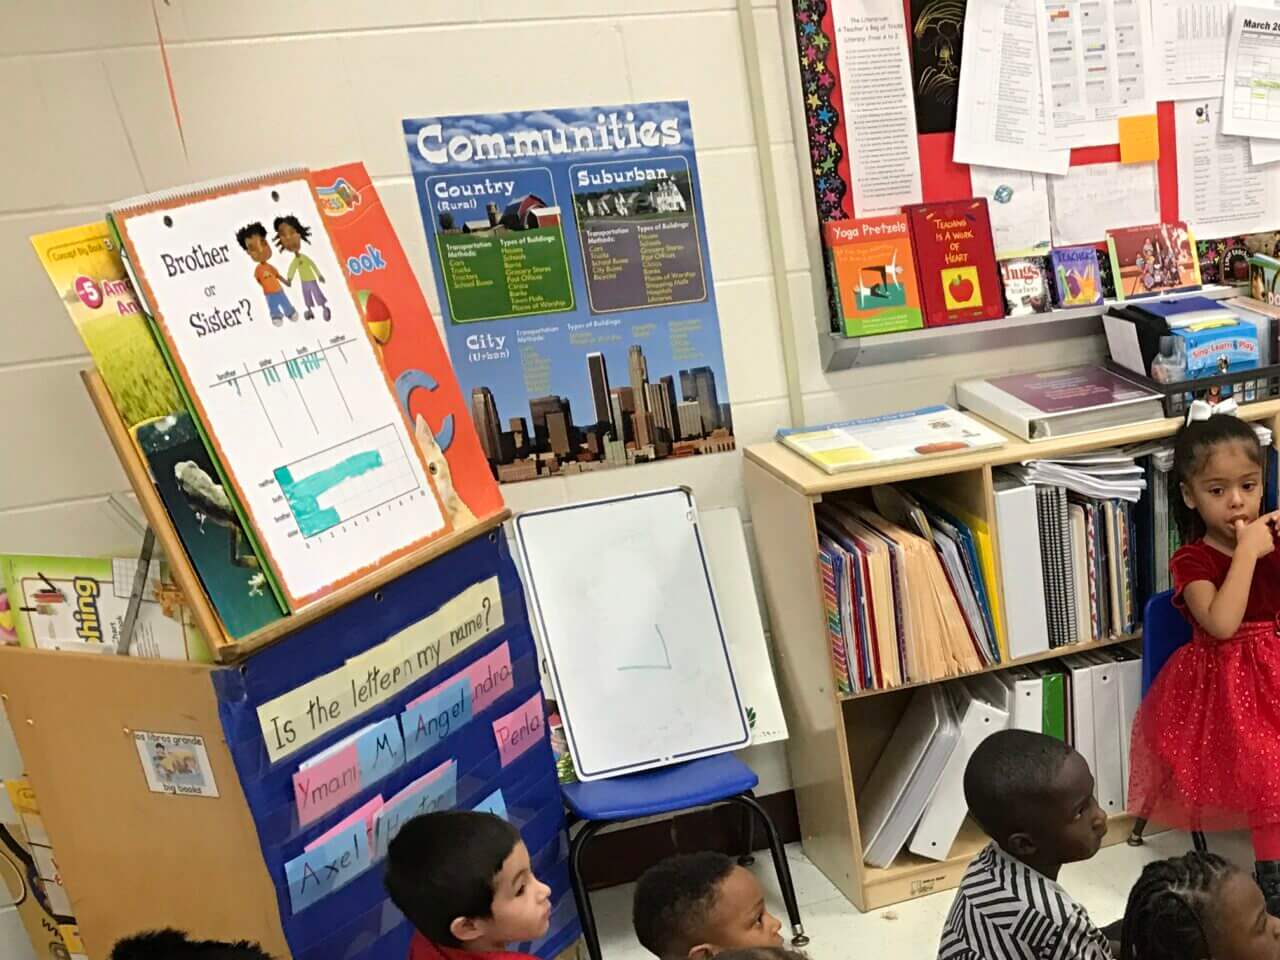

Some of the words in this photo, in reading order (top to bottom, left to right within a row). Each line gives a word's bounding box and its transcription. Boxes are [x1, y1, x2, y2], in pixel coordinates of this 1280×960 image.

[1243, 19, 1270, 31] March
[417, 111, 681, 165] Communities
[434, 178, 515, 198] Country
[577, 166, 668, 187] Suburban
[437, 199, 477, 211] (Rural)
[833, 227, 859, 240] Yoga
[862, 222, 906, 236] Pretzels
[51, 247, 76, 261] Concept
[160, 244, 230, 277] Brother
[347, 244, 387, 275] ook
[204, 285, 216, 298] or
[189, 298, 253, 338] Sister?
[466, 333, 506, 350] City
[468, 349, 510, 362] (Urban)
[1211, 341, 1232, 353] Learn
[1238, 340, 1255, 352] Play
[73, 576, 104, 643] hing
[270, 715, 297, 751] Is
[306, 694, 342, 731] the
[352, 667, 402, 708] letter
[416, 640, 442, 675] my
[450, 596, 492, 648] name?
[415, 691, 466, 742] Angel
[300, 833, 359, 896] Axel
